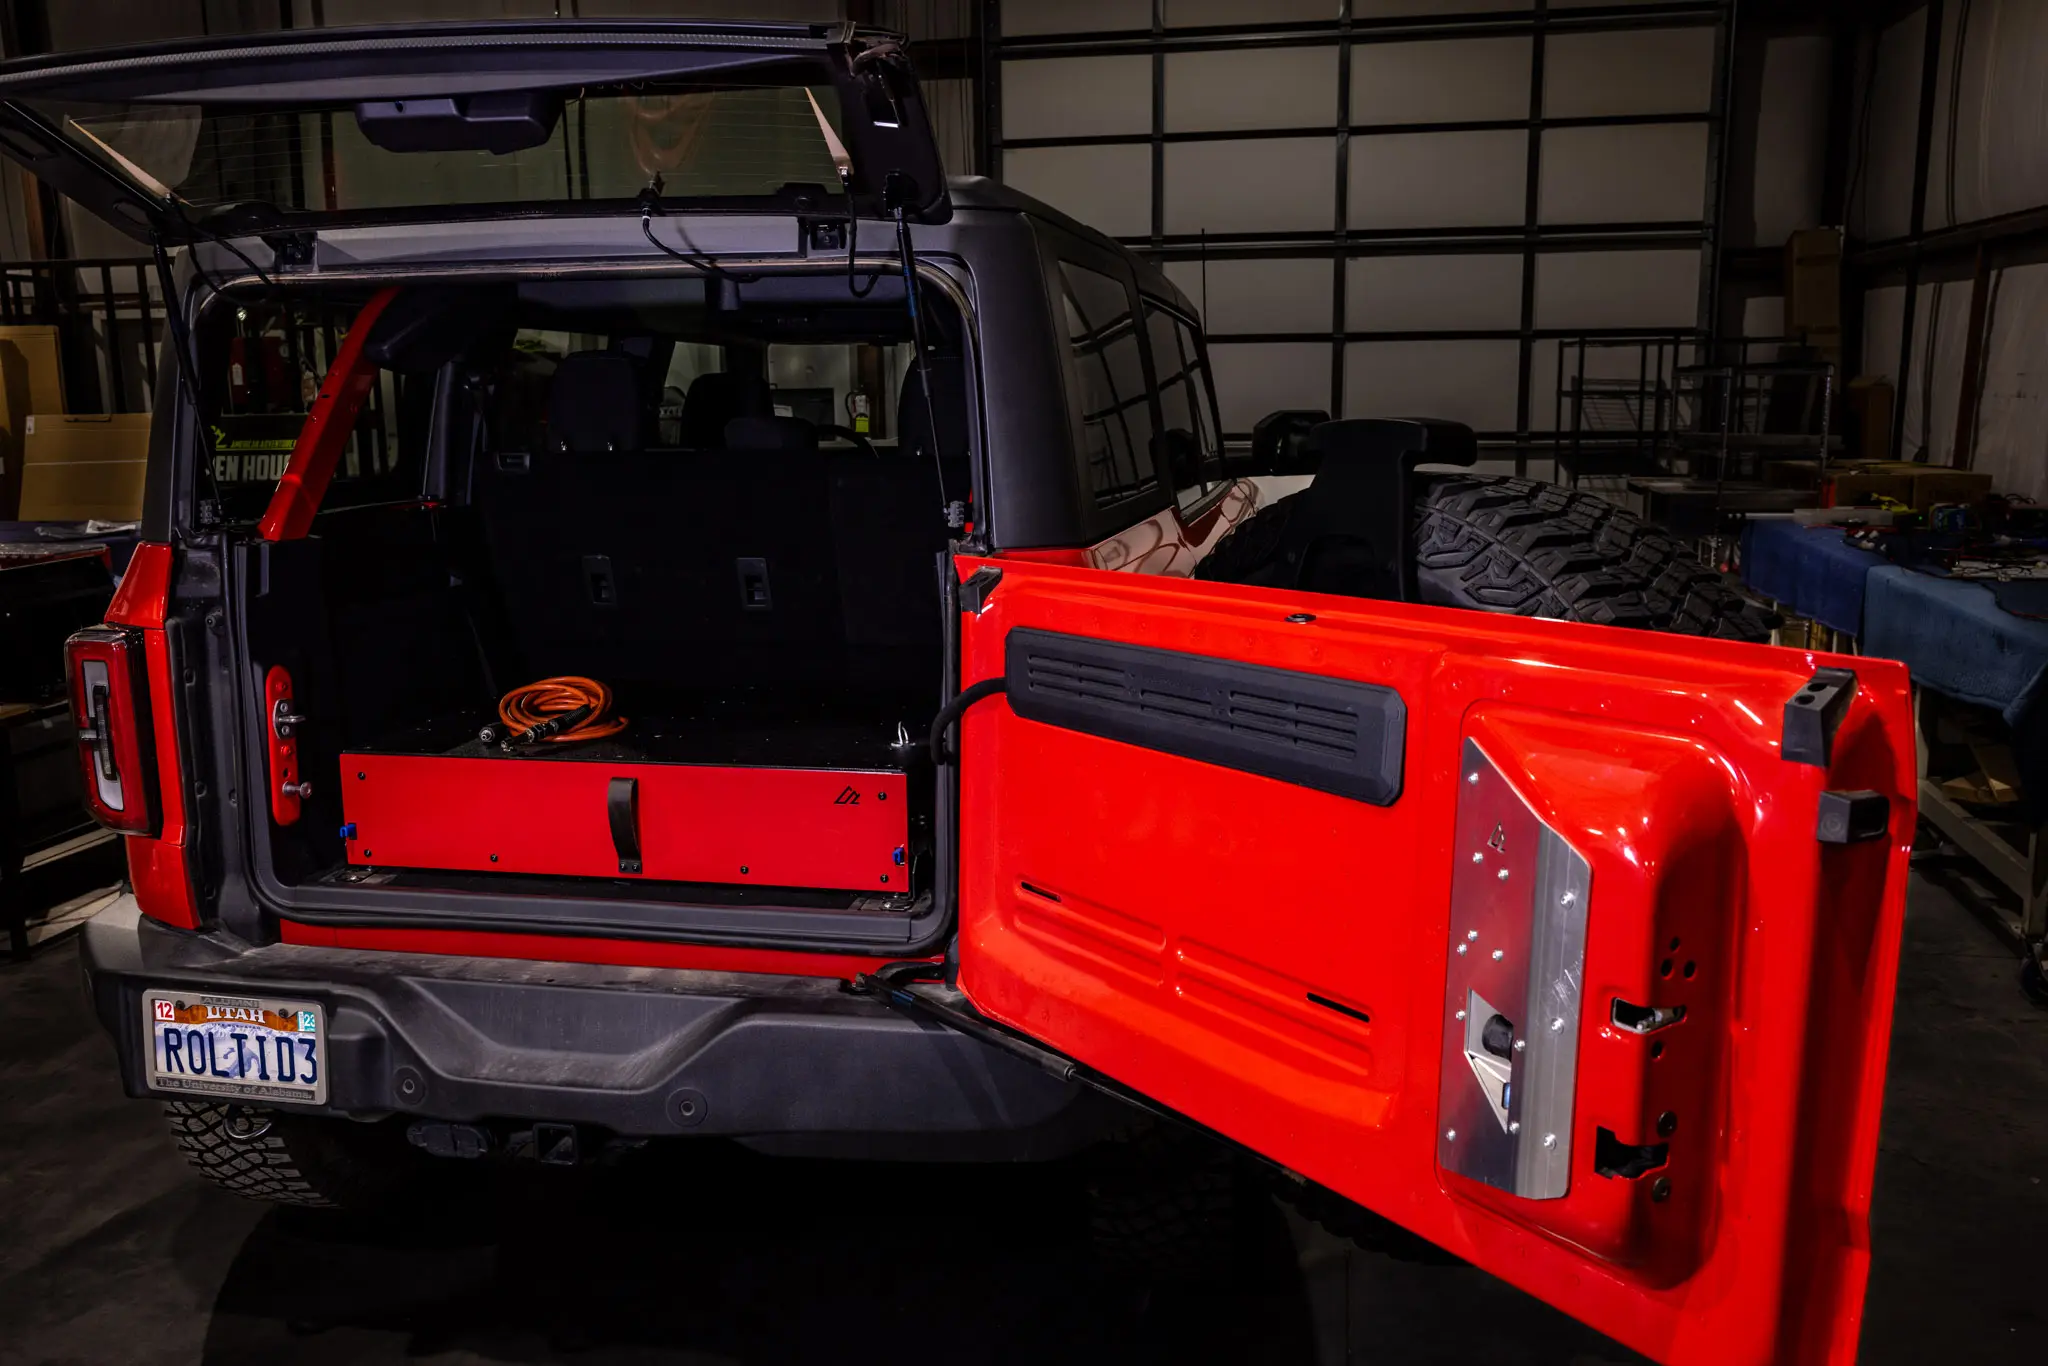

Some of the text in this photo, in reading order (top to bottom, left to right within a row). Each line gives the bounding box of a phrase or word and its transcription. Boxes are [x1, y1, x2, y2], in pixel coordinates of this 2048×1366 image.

[212, 455, 240, 481] EN
[157, 1002, 173, 1019] 12
[206, 1005, 266, 1024] UTAH
[304, 1013, 316, 1028] 23
[164, 1027, 318, 1084] ROLTID3
[157, 1077, 180, 1088] The
[182, 1079, 241, 1094] University
[243, 1085, 258, 1095] of
